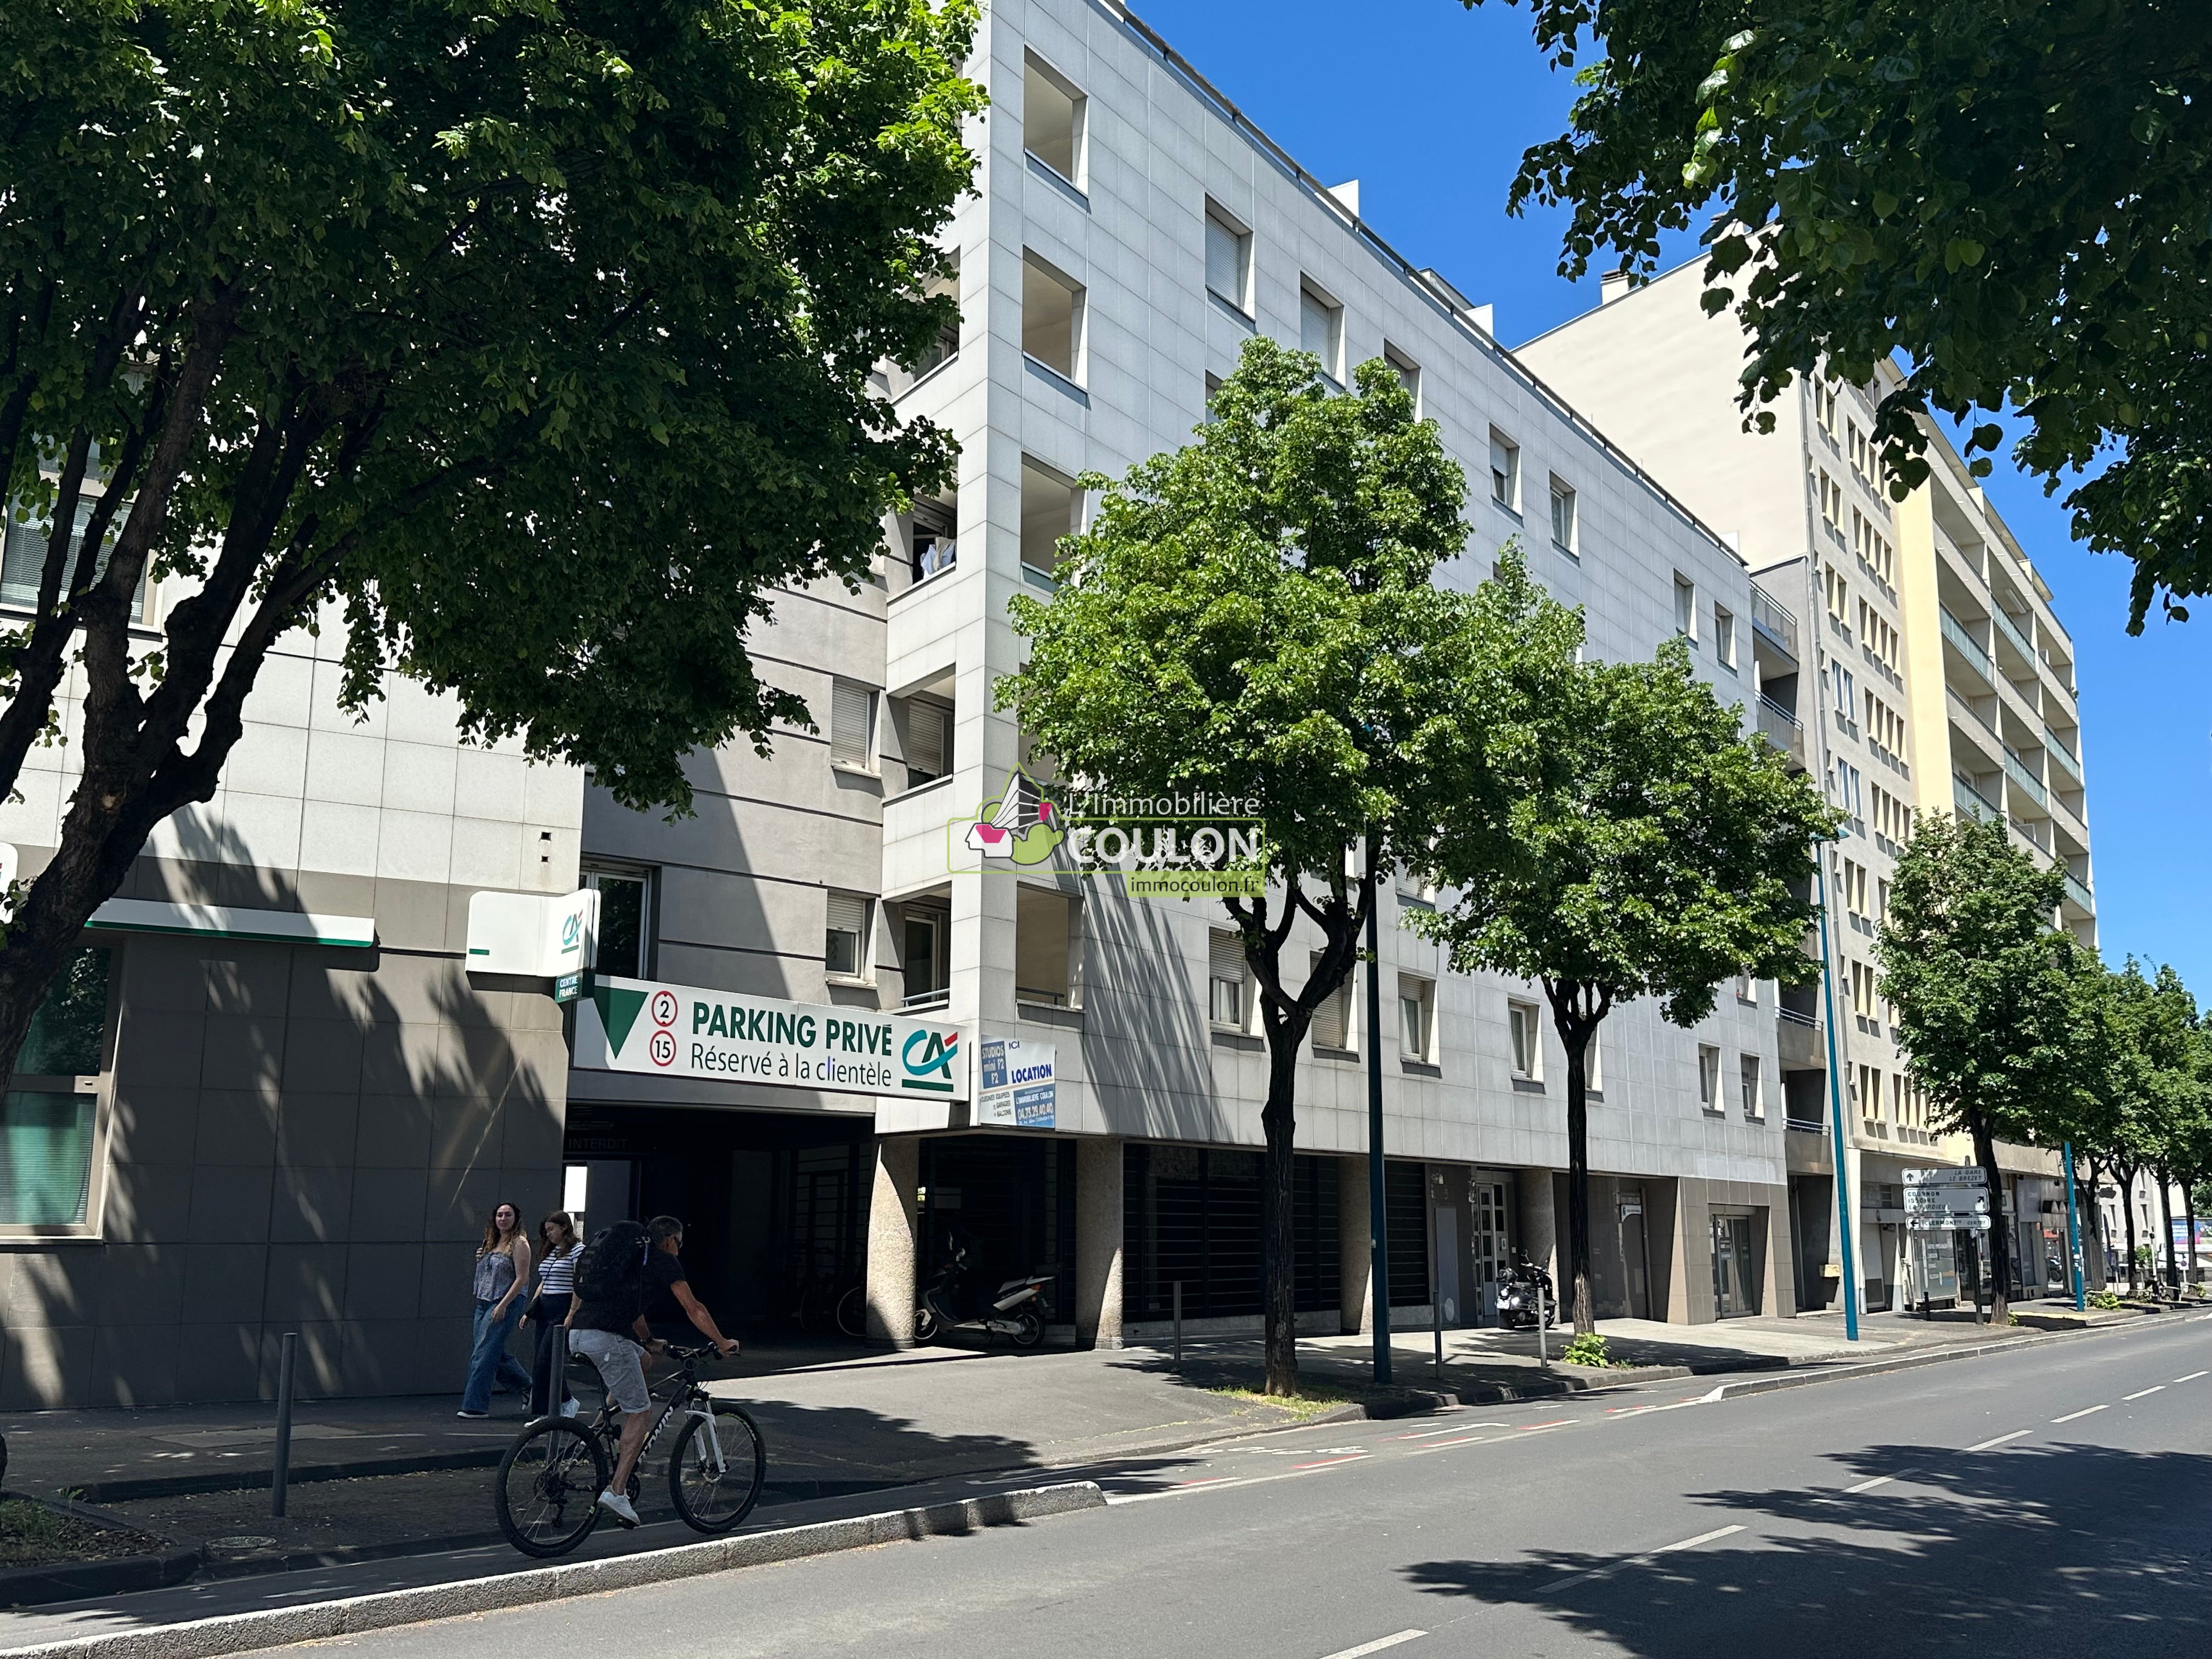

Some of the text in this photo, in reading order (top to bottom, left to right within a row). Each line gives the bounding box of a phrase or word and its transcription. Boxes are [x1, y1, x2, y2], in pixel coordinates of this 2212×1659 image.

[560, 976, 578, 988] CENTRE
[559, 986, 578, 998] FRANCE
[660, 1000, 669, 1018] 2
[692, 1001, 892, 1057] PARKING PRIVÉ
[656, 1040, 670, 1059] 15
[1008, 1041, 1020, 1049] ICI
[982, 1045, 1004, 1059] STUDIOS
[691, 1043, 891, 1087] Réservé à la clientèle
[997, 1058, 1005, 1070] F2
[991, 1072, 998, 1084] F2
[1011, 1064, 1052, 1084] LOCATION
[569, 1138, 628, 1149] INTERDIT
